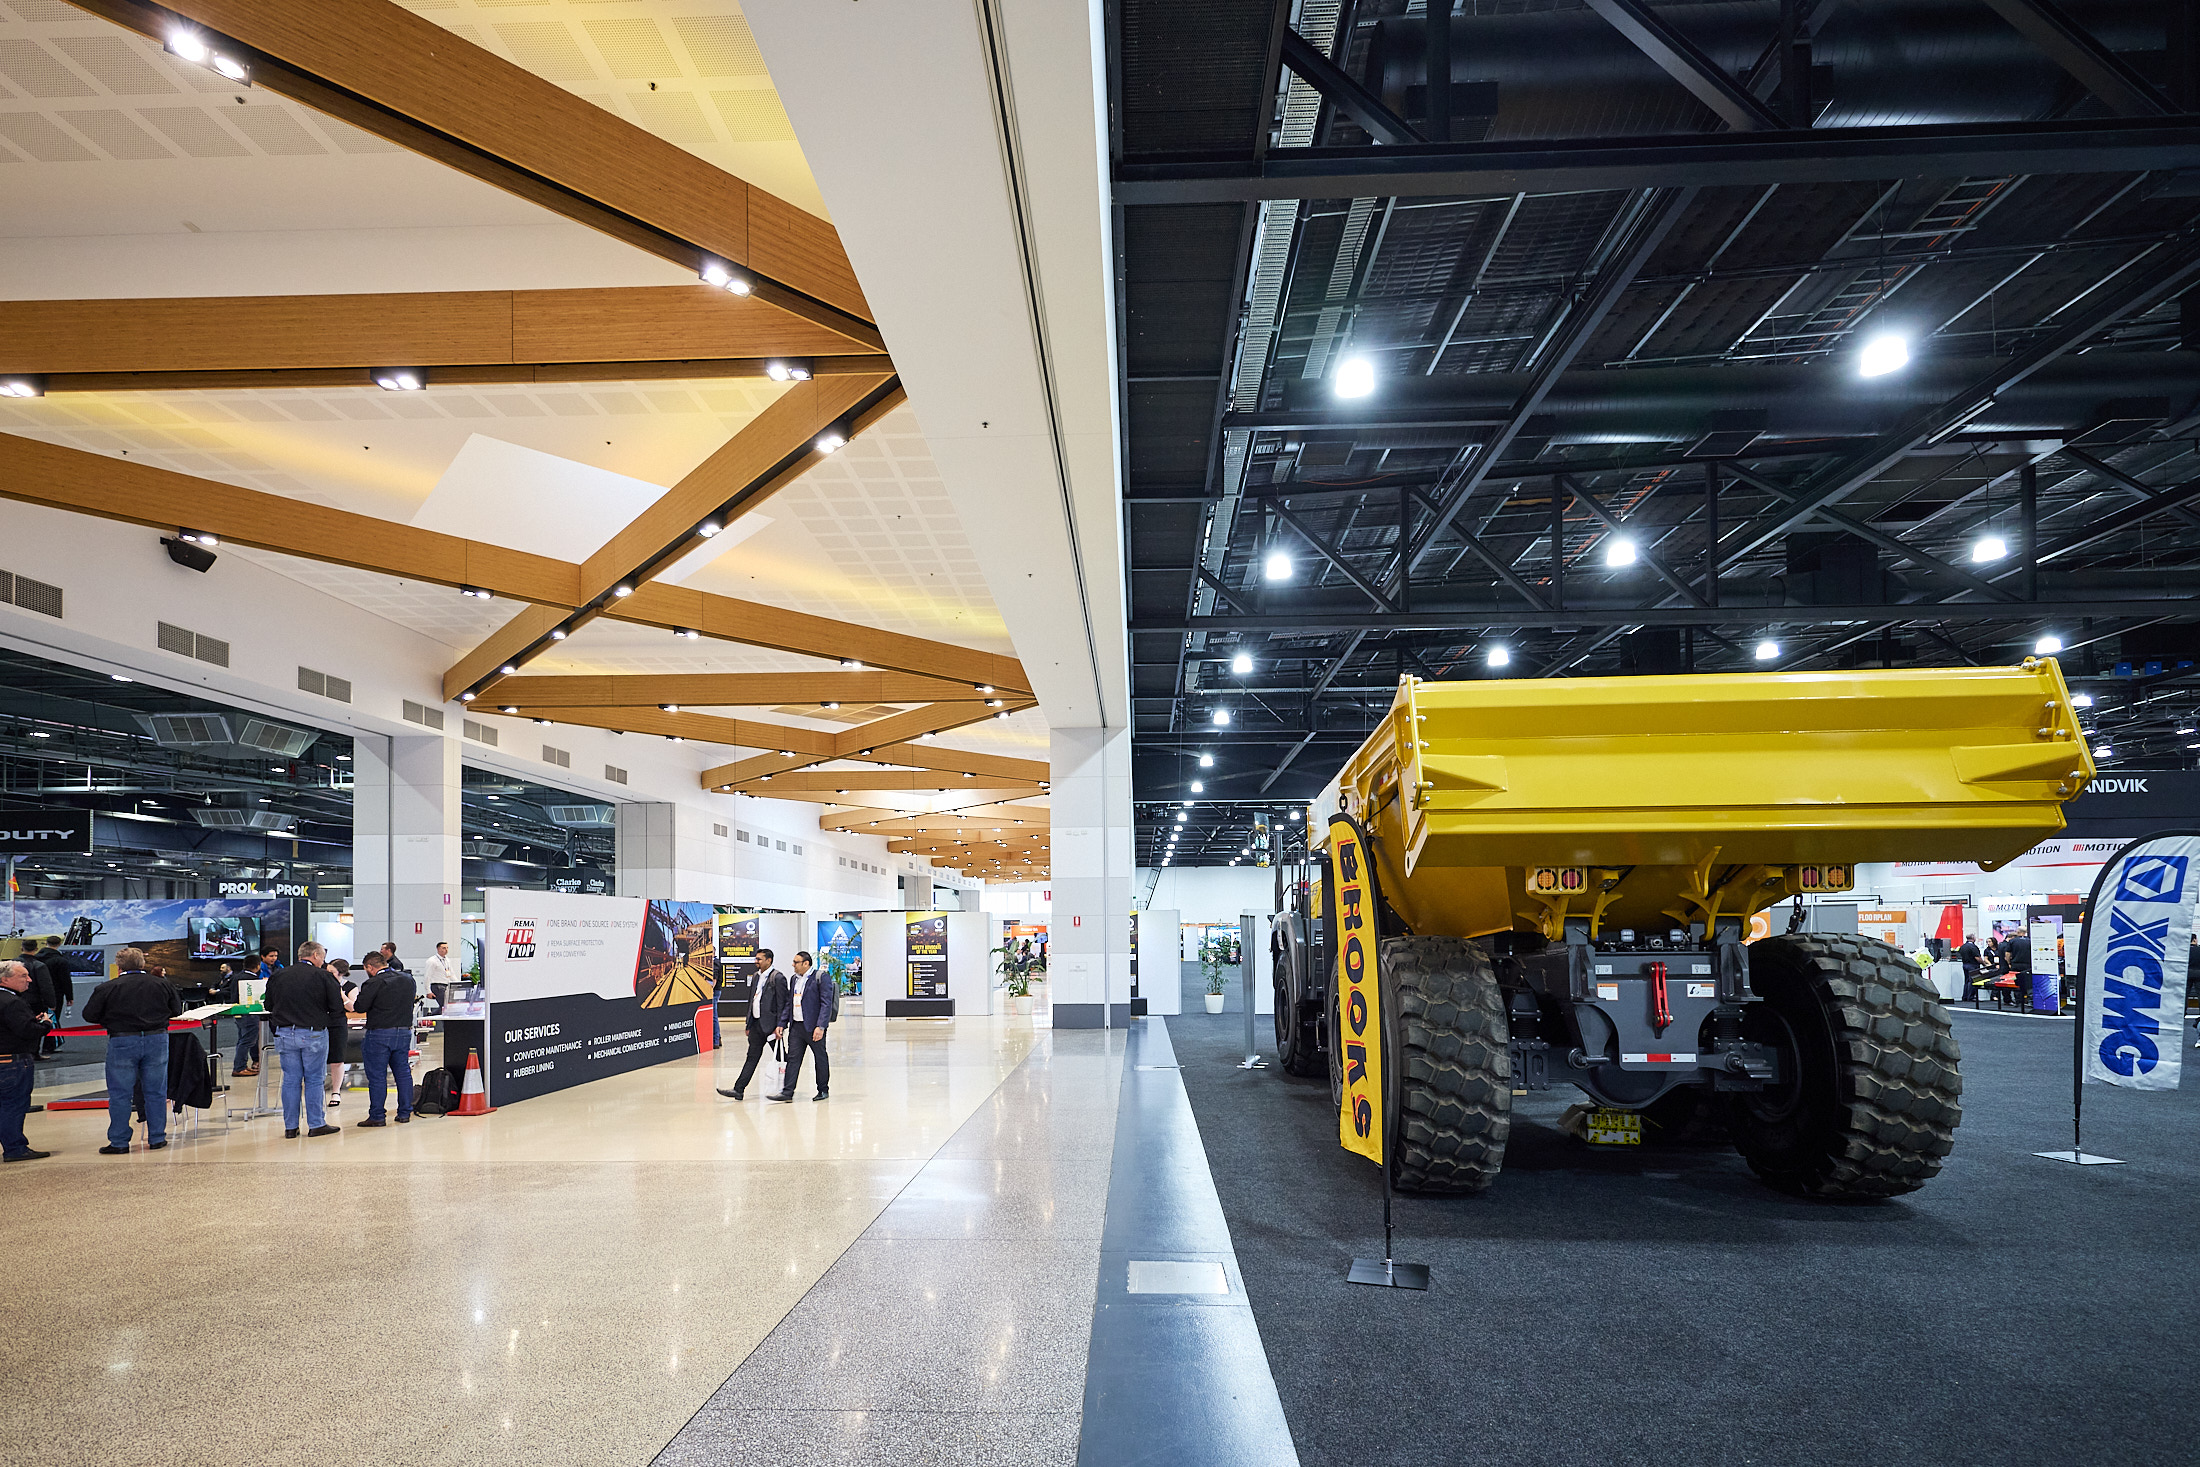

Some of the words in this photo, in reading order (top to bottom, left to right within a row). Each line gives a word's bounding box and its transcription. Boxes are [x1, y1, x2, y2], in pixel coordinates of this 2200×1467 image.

[219, 882, 257, 894] PROK
[277, 883, 309, 897] PROK
[549, 920, 560, 928] ONE
[560, 920, 578, 928] BRAND
[581, 920, 592, 928] ONE
[592, 920, 609, 928] SOURCE
[507, 929, 533, 943] TIP
[510, 943, 535, 958] TOP
[1337, 839, 1372, 1140] BROOKS
[2099, 905, 2169, 1076] XCMG
[668, 1021, 682, 1031] MINING
[682, 1019, 693, 1028] HOSES
[504, 1029, 523, 1043] OUR
[523, 1023, 560, 1040] SERVICES
[593, 1034, 611, 1045] ROLLER
[611, 1029, 642, 1042] MAINTENANCE
[668, 1031, 692, 1043] ENGINEERING
[513, 1047, 545, 1062] CONVEYOR
[545, 1040, 582, 1055] MAINTENANCE
[593, 1047, 622, 1059] MECHANICAL
[622, 1042, 645, 1053] CONVEYOR
[644, 1038, 660, 1049] SERVICE
[513, 1065, 536, 1078] RUBBER
[536, 1061, 555, 1073] LINING
